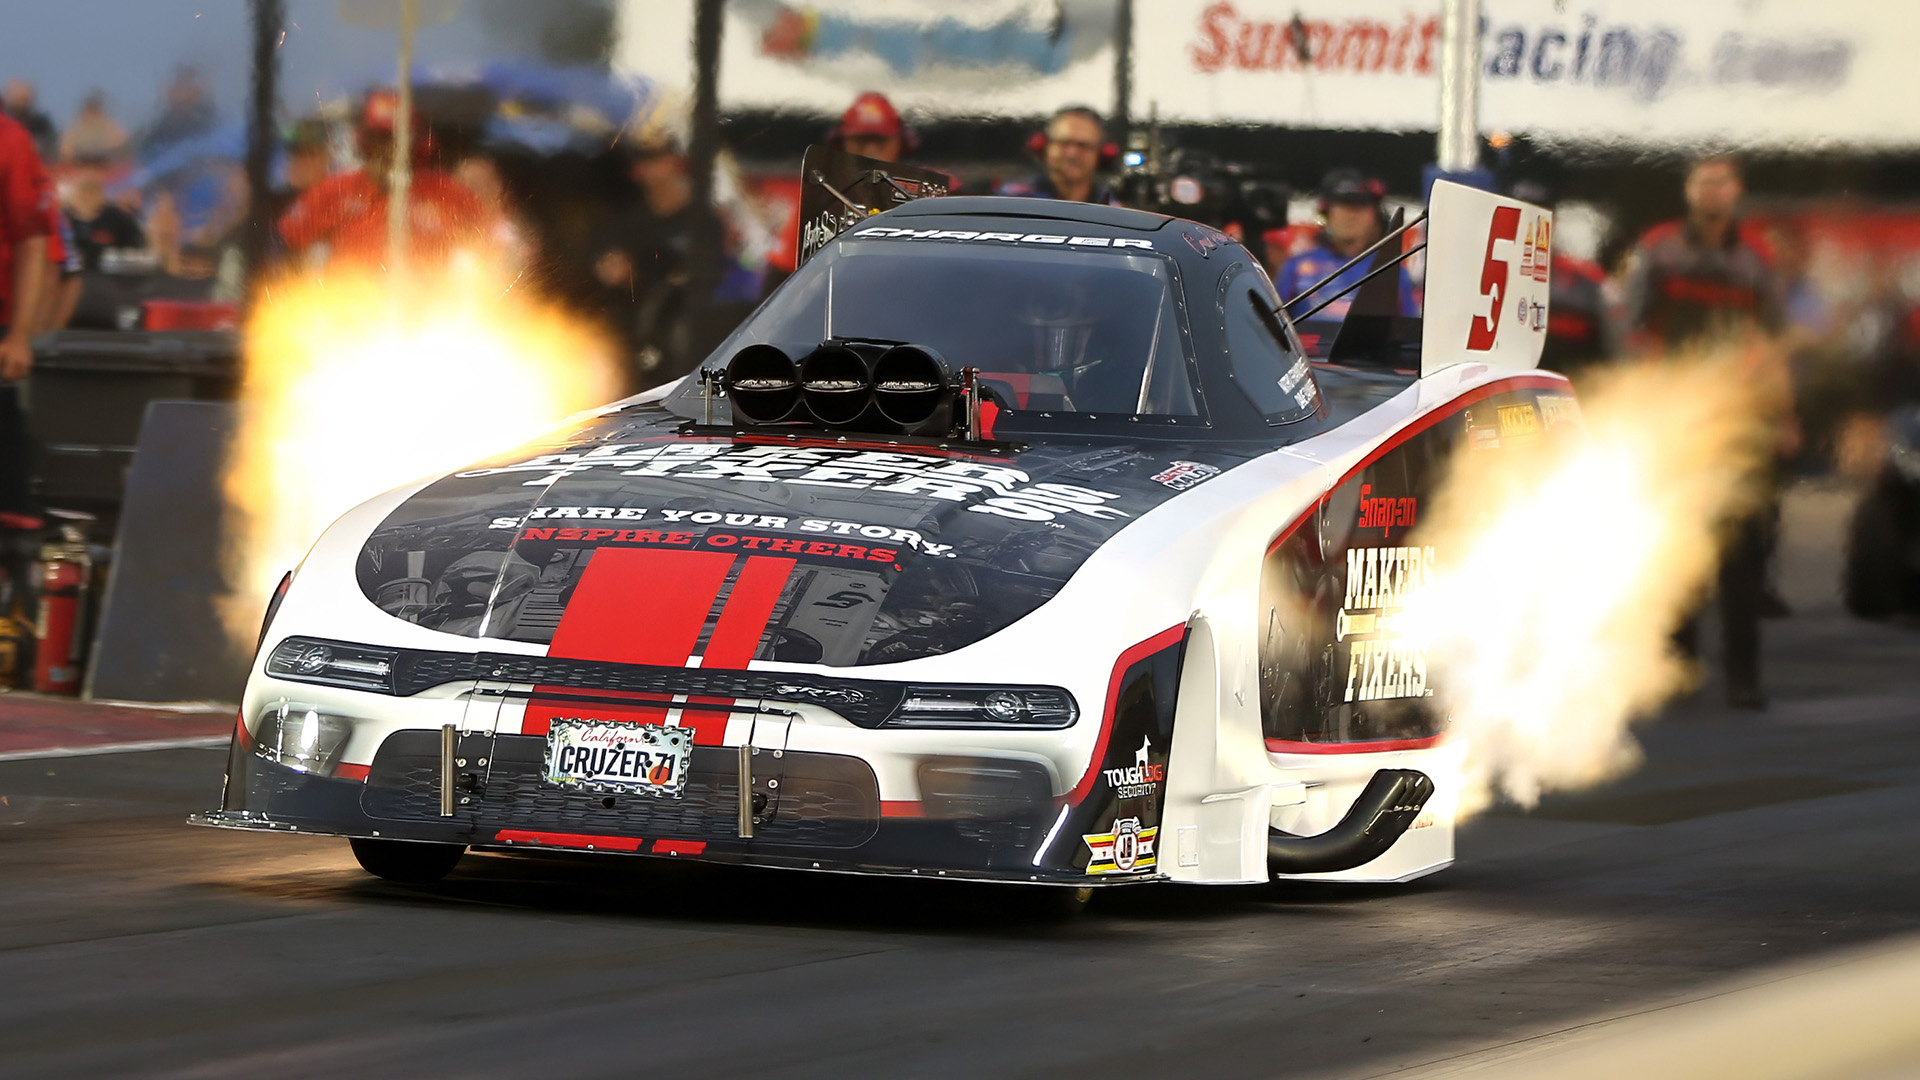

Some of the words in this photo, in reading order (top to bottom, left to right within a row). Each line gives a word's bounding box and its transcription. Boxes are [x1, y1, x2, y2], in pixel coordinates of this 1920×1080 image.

[853, 227, 1155, 250] CHARGER
[1466, 206, 1522, 351] 5
[489, 506, 648, 529] SHARE
[661, 508, 789, 529] YOUR
[800, 518, 957, 559] STORY.
[1359, 484, 1417, 538] Snap-on
[706, 534, 903, 571] OTHERS.
[1344, 546, 1435, 610] MAKERS
[1343, 640, 1428, 703] FIXERS
[559, 745, 652, 779] CRUZER
[654, 752, 676, 781] 71
